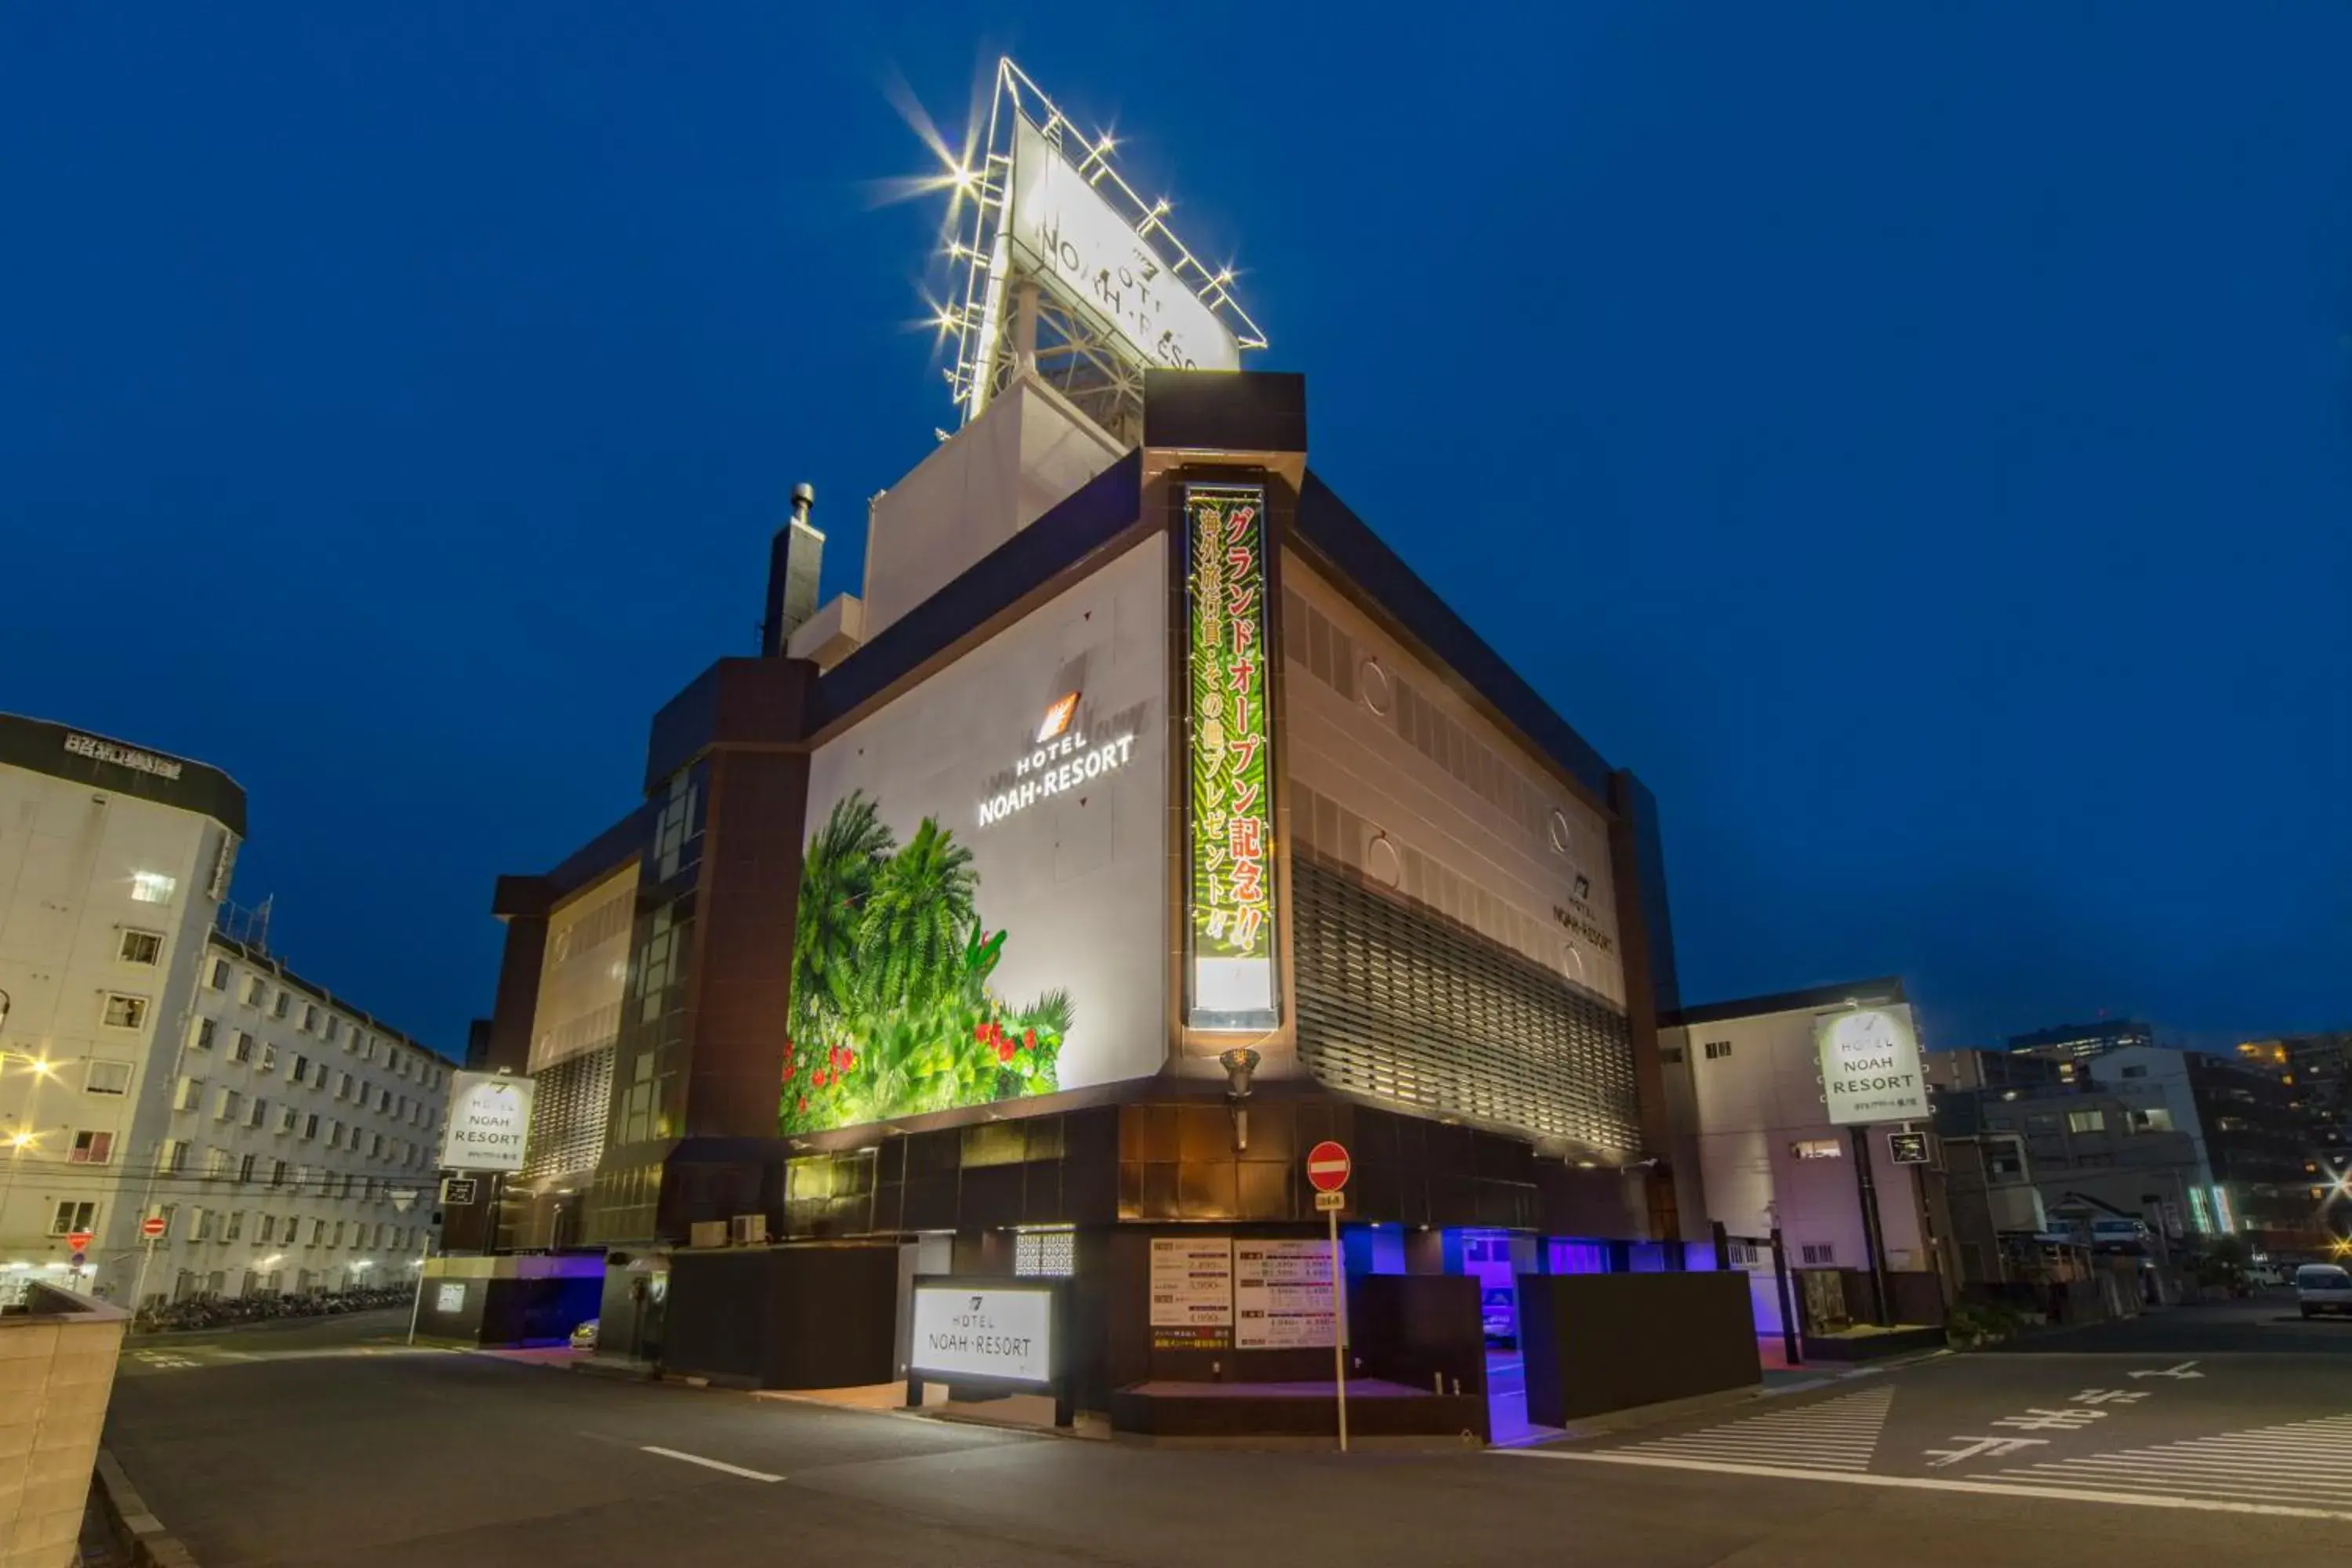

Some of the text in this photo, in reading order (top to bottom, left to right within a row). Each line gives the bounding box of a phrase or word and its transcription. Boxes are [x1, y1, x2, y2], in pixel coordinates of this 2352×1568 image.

[1016, 731, 1087, 778] HOTEL
[1844, 1057, 1893, 1073] NOAH
[1833, 1074, 1914, 1094] RESORT
[470, 1116, 510, 1127] NOAH
[455, 1131, 521, 1145] RESORT
[953, 1315, 996, 1329] HOTEL
